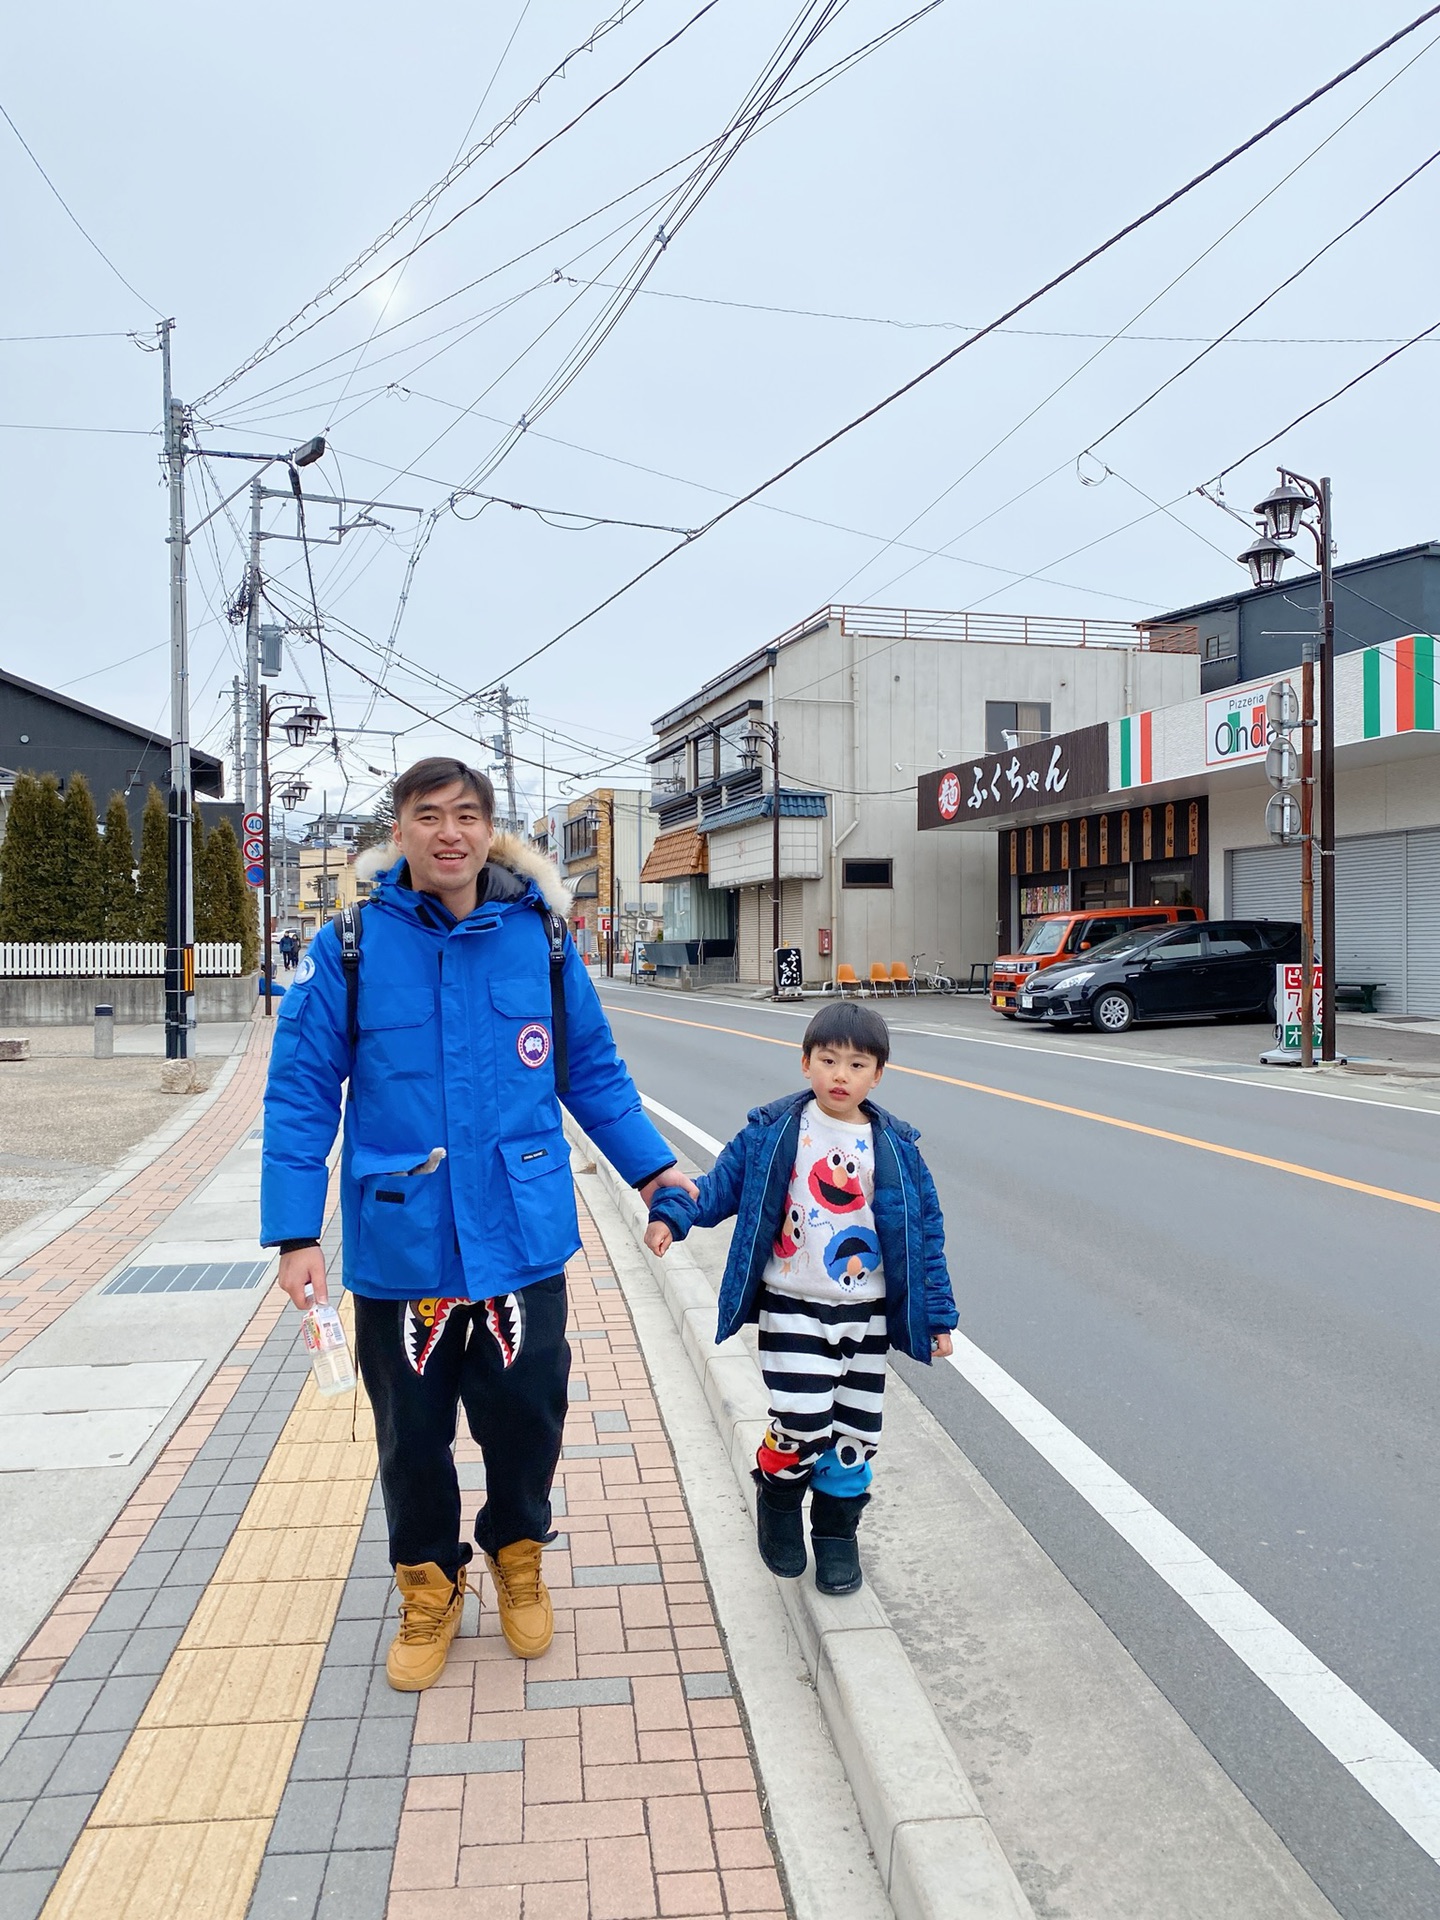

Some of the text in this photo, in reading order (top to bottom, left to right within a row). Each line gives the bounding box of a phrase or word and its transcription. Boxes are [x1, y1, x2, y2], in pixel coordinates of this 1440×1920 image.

[1229, 694, 1264, 710] Pizzeria
[938, 745, 1070, 813] 麺 ふくちゃん
[248, 819, 261, 830] 40
